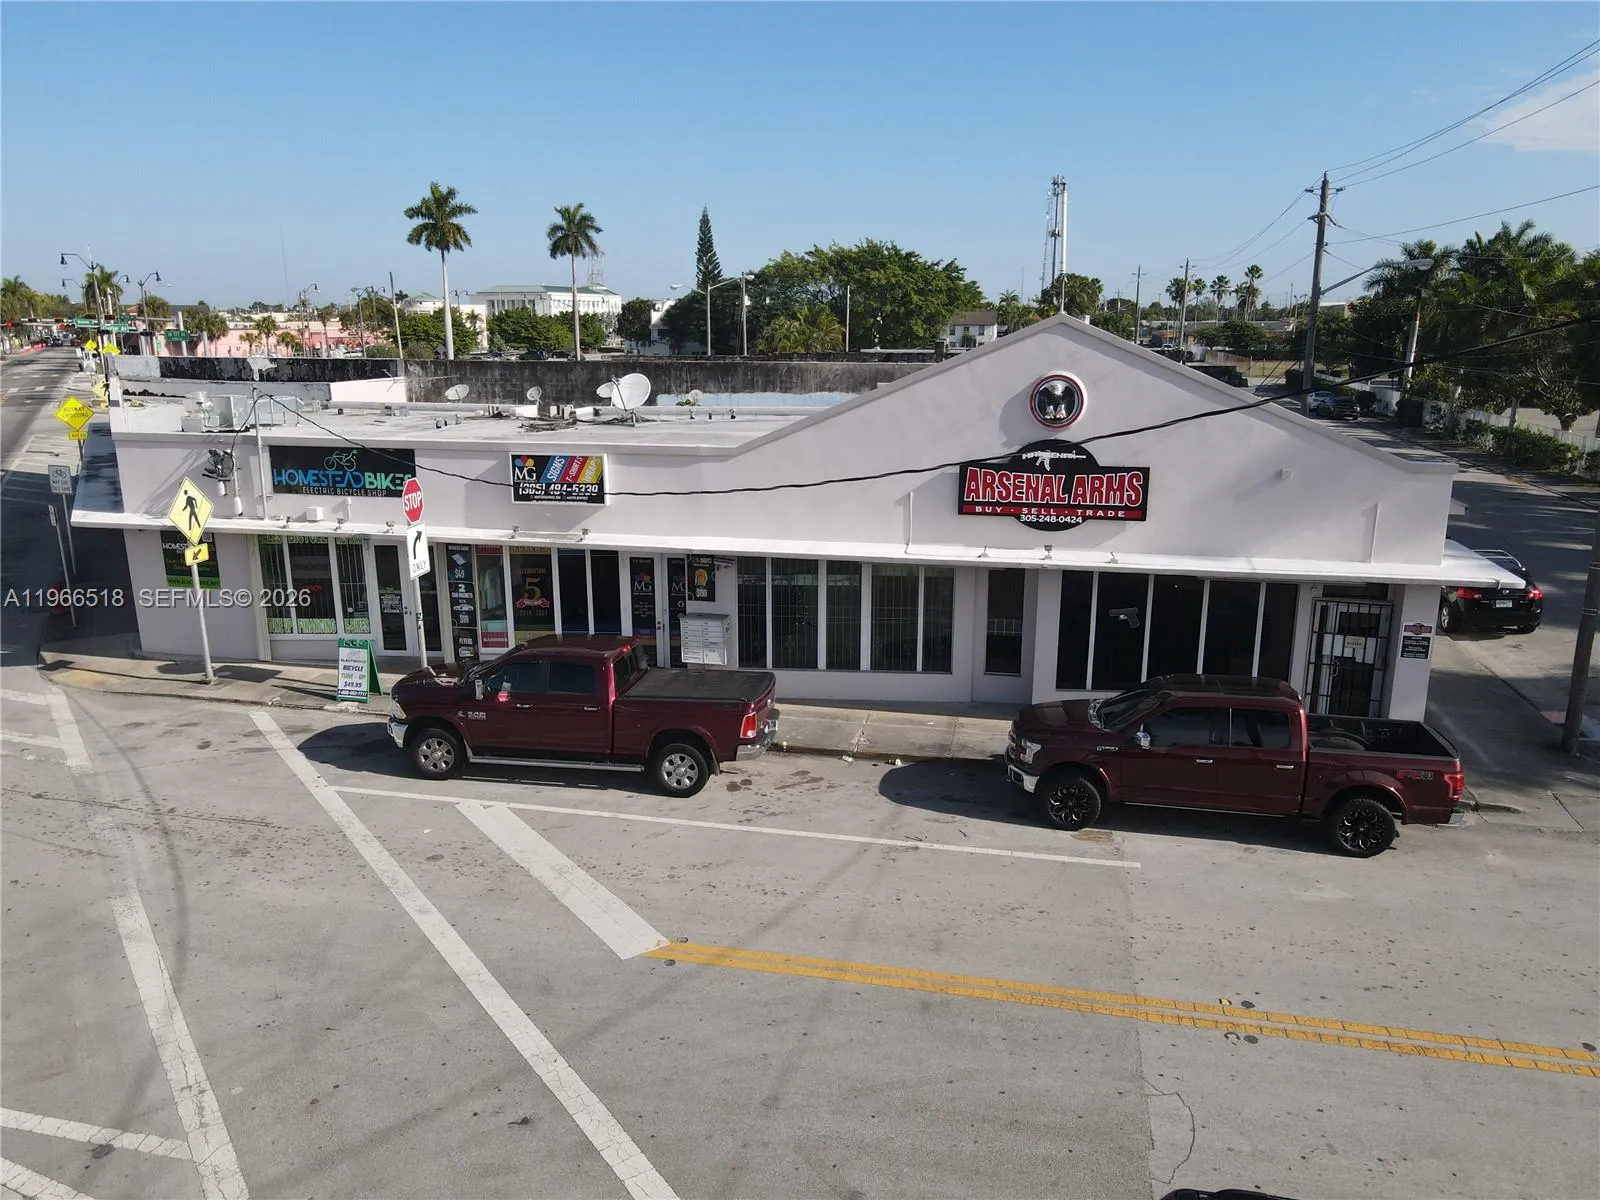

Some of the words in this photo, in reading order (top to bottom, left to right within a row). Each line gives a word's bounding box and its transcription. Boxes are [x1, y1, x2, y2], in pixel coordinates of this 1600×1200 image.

[514, 466, 537, 481] MG
[547, 455, 565, 482] SIGNS
[566, 456, 584, 482] T-SHIRTS
[583, 456, 601, 483] WRAPS
[272, 468, 365, 488] HOMESTEAD
[963, 466, 1069, 505] ARSENAL
[1070, 471, 1144, 507] ARMS
[302, 486, 335, 495] ELECTRIC
[336, 488, 365, 496] BICYCLE
[367, 489, 387, 497] SHOP
[404, 490, 422, 512] STOP
[975, 505, 1003, 514] BUY
[1021, 507, 1058, 515] SELL
[1076, 509, 1126, 517] TRADE
[1019, 514, 1083, 524] 305-248-0424
[411, 559, 428, 575] ONLY
[458, 584, 466, 593] 2
[524, 576, 542, 601] 5
[633, 580, 652, 591] MG
